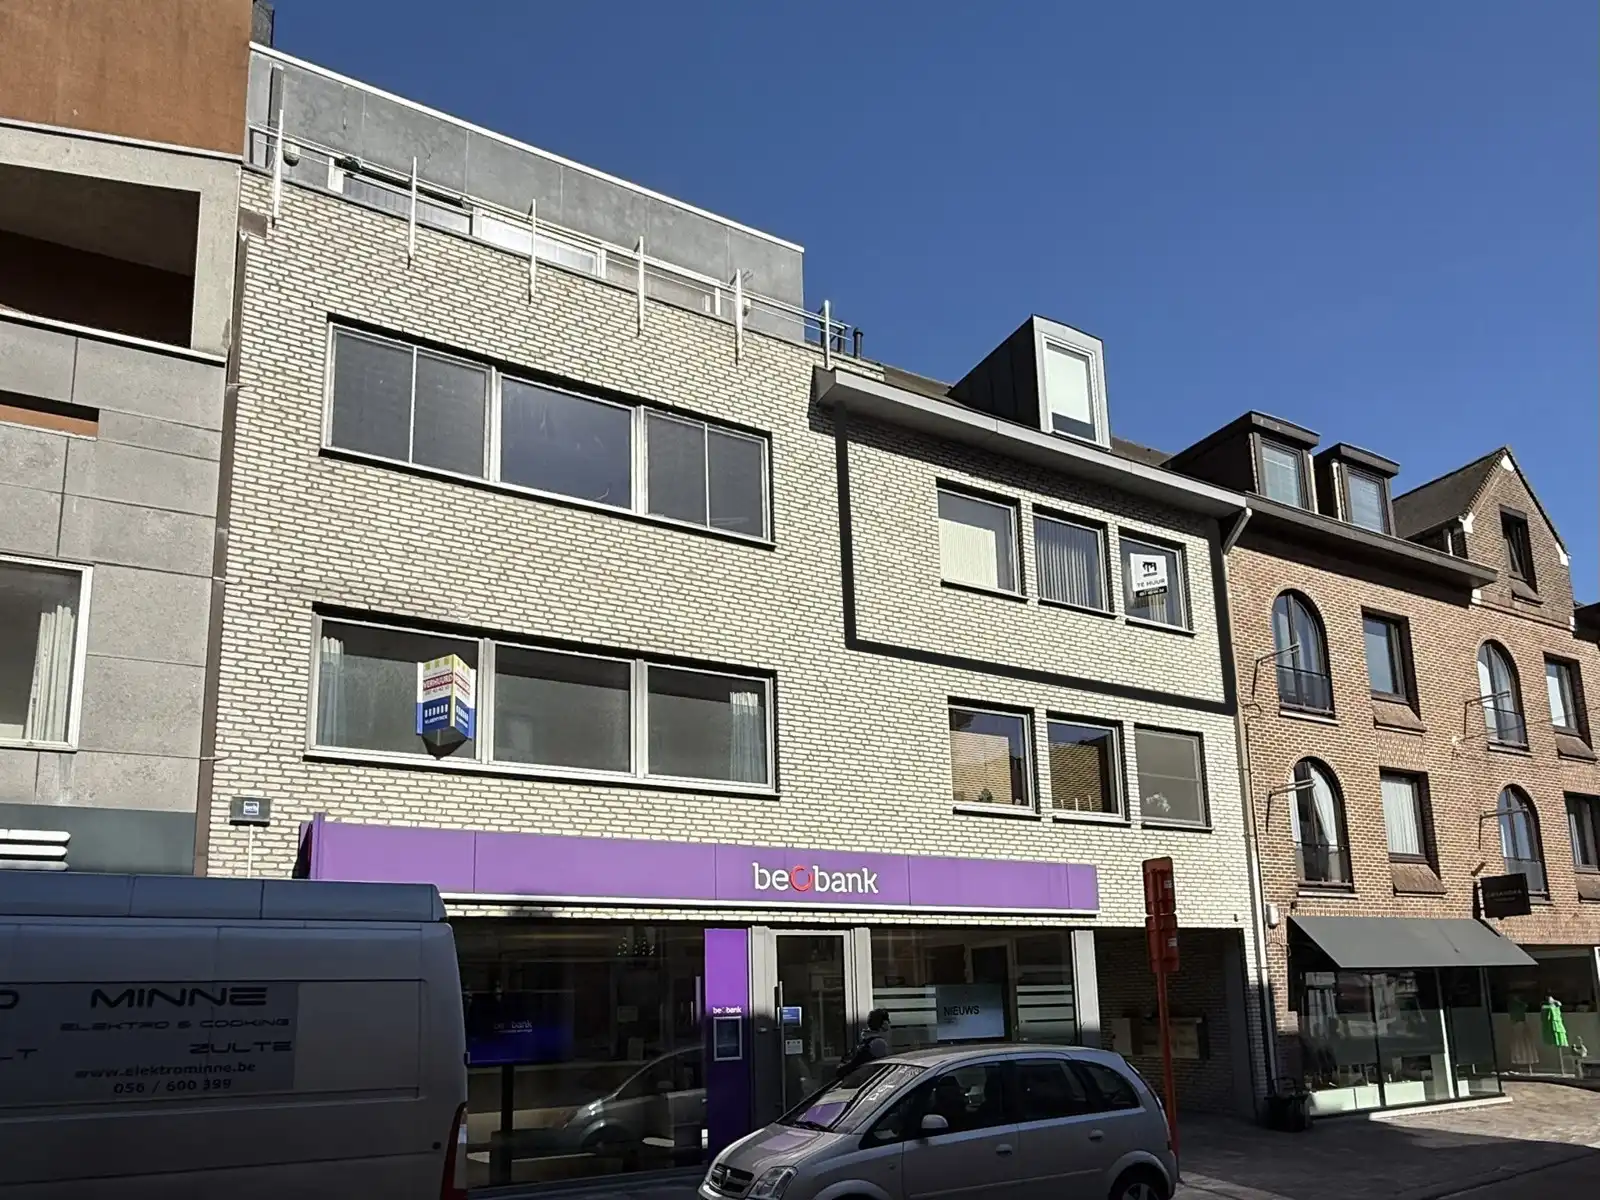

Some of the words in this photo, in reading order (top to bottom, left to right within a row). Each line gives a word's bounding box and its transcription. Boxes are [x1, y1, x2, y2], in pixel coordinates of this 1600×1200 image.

[1146, 578, 1165, 587] HUUR
[90, 987, 268, 1008] MINNE
[943, 1005, 980, 1017] NIEUWS
[60, 1020, 169, 1031] ELEKTRO
[178, 1020, 192, 1030] &
[200, 1018, 292, 1028] COOKING
[190, 1041, 293, 1054] ZULTE
[75, 1062, 256, 1079] www.elektrominne.be
[113, 1083, 145, 1094] 056
[151, 1080, 161, 1095] /
[166, 1079, 197, 1092] 600
